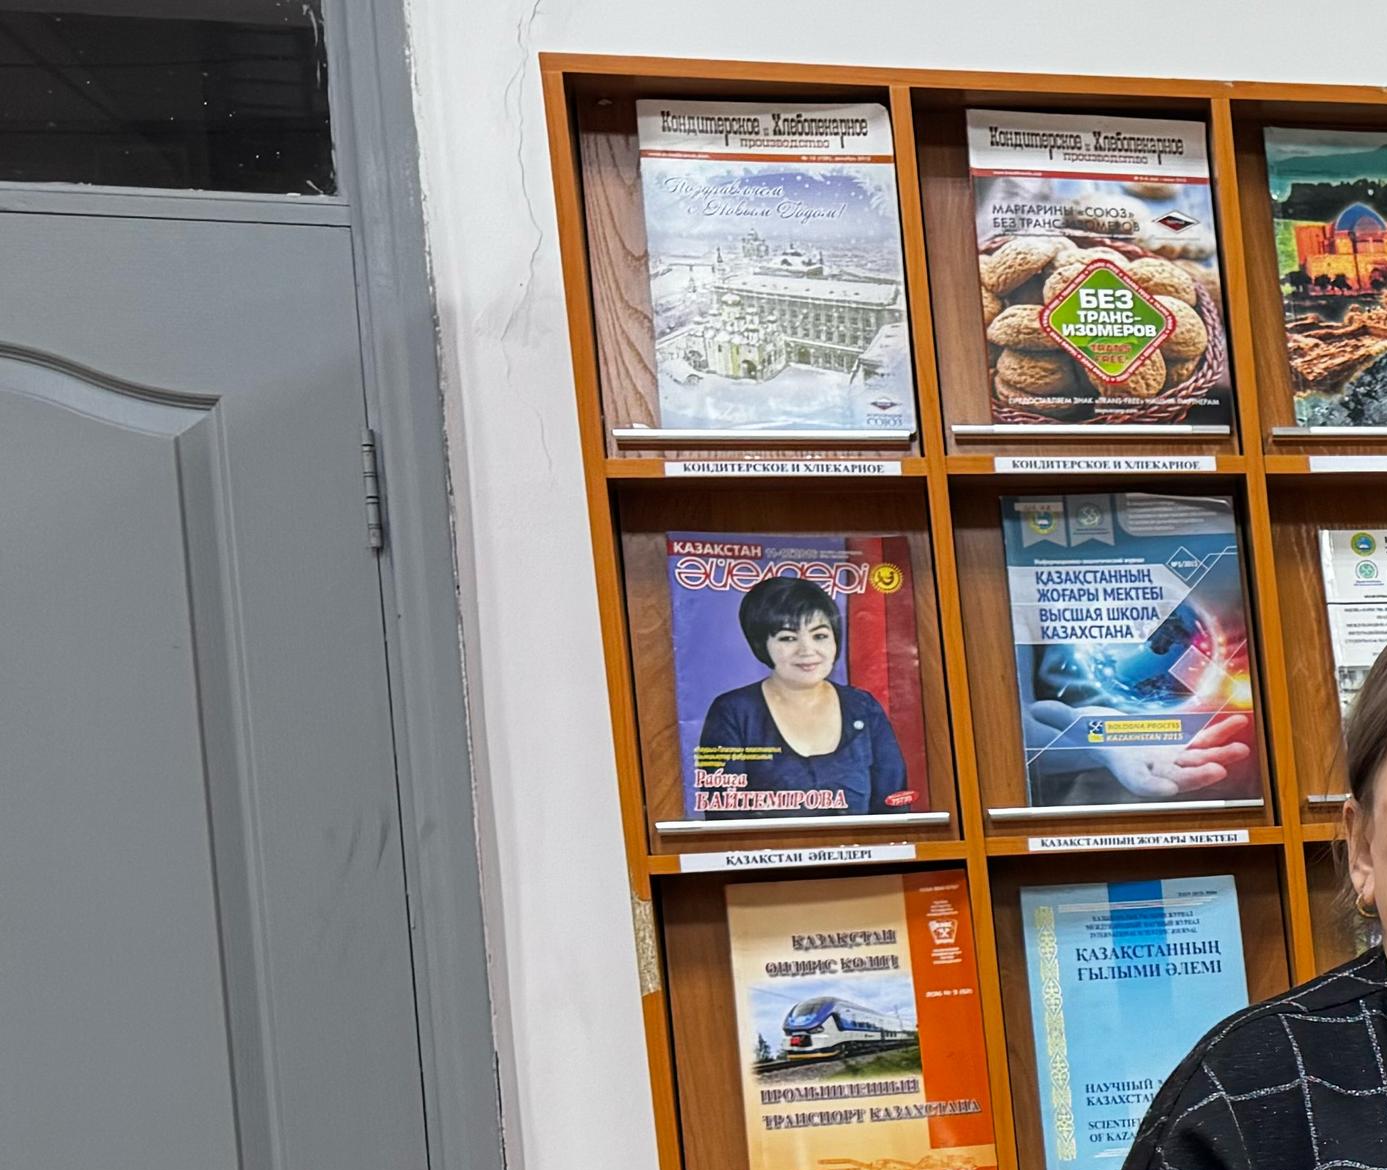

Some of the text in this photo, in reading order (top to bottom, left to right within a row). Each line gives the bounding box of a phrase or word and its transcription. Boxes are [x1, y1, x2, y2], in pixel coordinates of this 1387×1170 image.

[661, 111, 869, 148] Кондитерское Хлебопекарное
[989, 126, 1083, 160] Кондитерское
[992, 204, 1073, 218] МАРГАРИНЫ
[992, 218, 1016, 230] БЕЗ
[1079, 288, 1133, 310] БЕЗ
[1078, 309, 1141, 324] ТРАНС-
[1062, 323, 1156, 338] ИЗОМЕРОВ
[683, 463, 789, 472] КОНДИТЕРСКОЕ
[1012, 459, 1110, 470] КОНДИТЕРСКОЕ
[1036, 569, 1152, 585] ҚАЗАҚСТАННЫҢ
[1037, 587, 1162, 602] ЖОҒАРЫ МЕКТЕБІ
[1040, 607, 1159, 622] ВЫСШАЯ ШКОЛА
[1041, 625, 1133, 639] КАЗАХСТАНА
[695, 790, 847, 811] БАЙТЕМІРОВА
[808, 850, 871, 861] ӘЙЕЛДЕРІ
[1076, 940, 1221, 961] ҚАЗАҚСТАННЫҢ
[1078, 960, 1221, 981] ҒЫЛЫМИ ӘЛЕМІ
[1085, 1079, 1154, 1095] НАУЧНЫЙ
